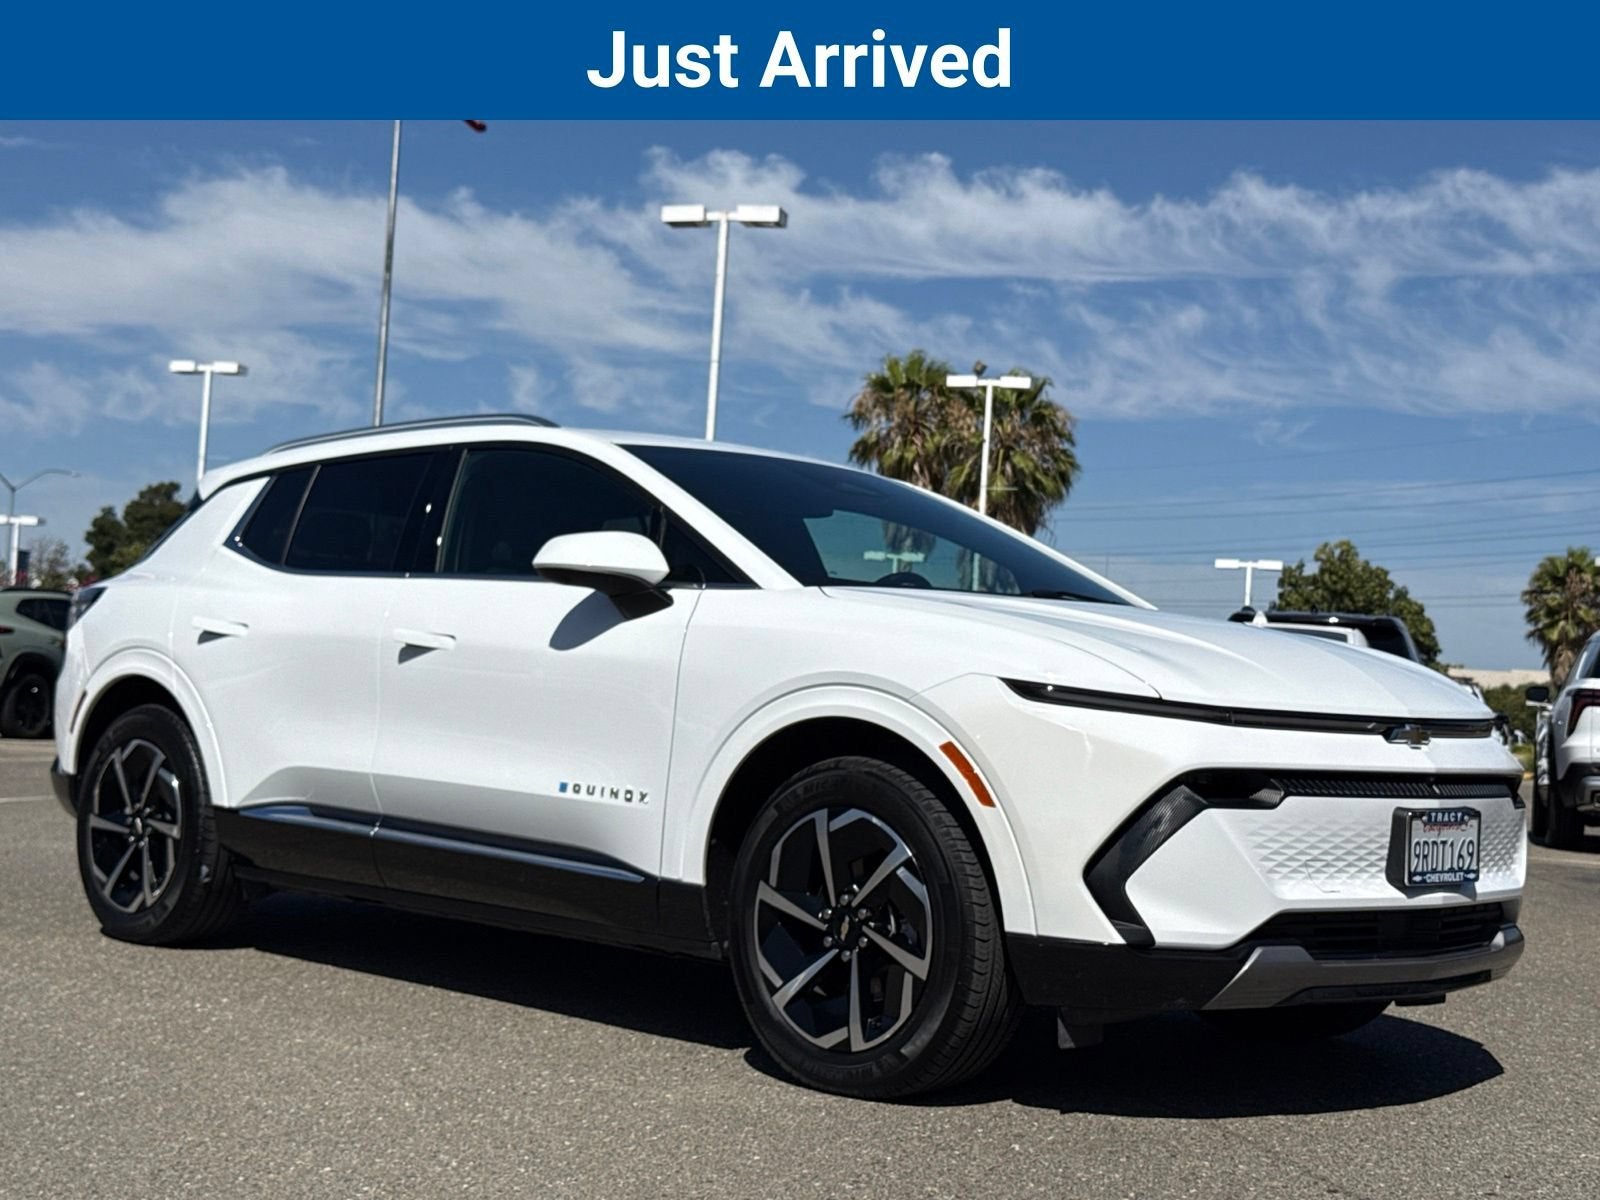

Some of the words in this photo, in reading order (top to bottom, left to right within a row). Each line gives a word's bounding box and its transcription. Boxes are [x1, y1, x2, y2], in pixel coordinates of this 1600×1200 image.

[1430, 812, 1463, 822] TRACY
[1413, 839, 1475, 872] 9RDT169
[1425, 872, 1465, 883] CHEVROLET
